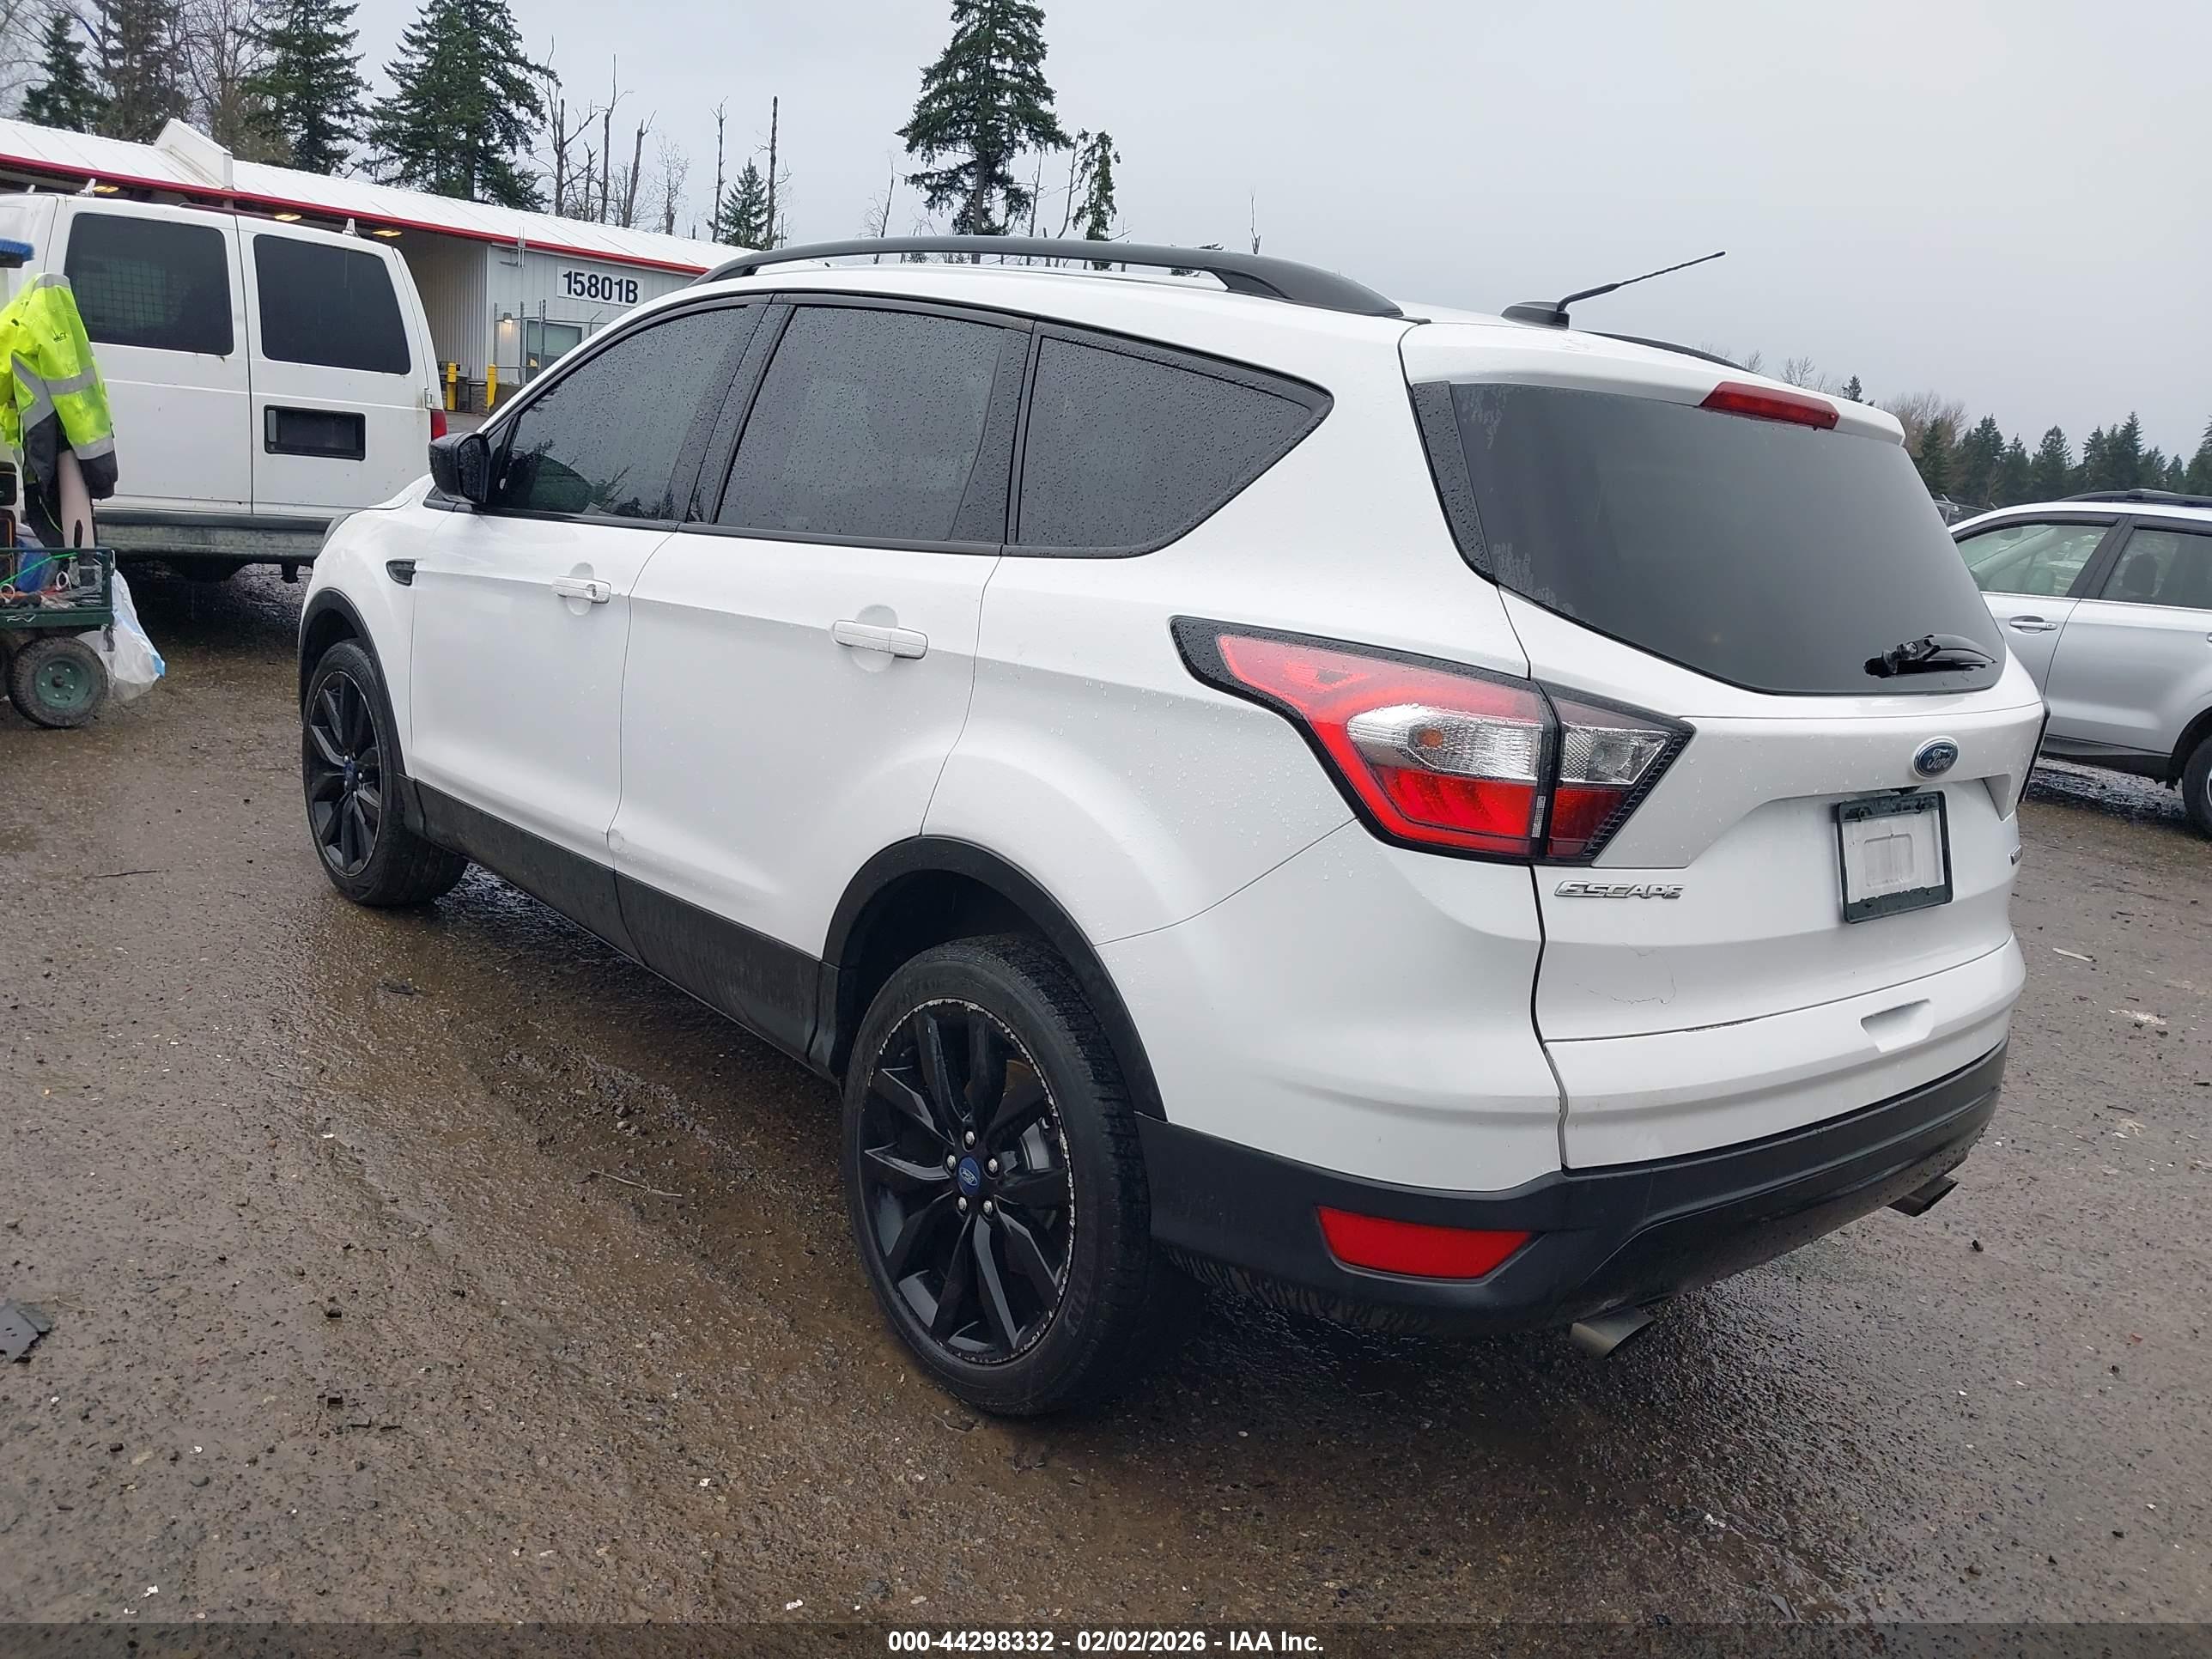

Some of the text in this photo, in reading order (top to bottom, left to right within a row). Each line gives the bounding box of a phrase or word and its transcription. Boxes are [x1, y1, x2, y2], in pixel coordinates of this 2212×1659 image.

[562, 270, 639, 304] 15801B
[1926, 748, 1954, 770] Ford
[1554, 879, 1685, 899] ESCAPE
